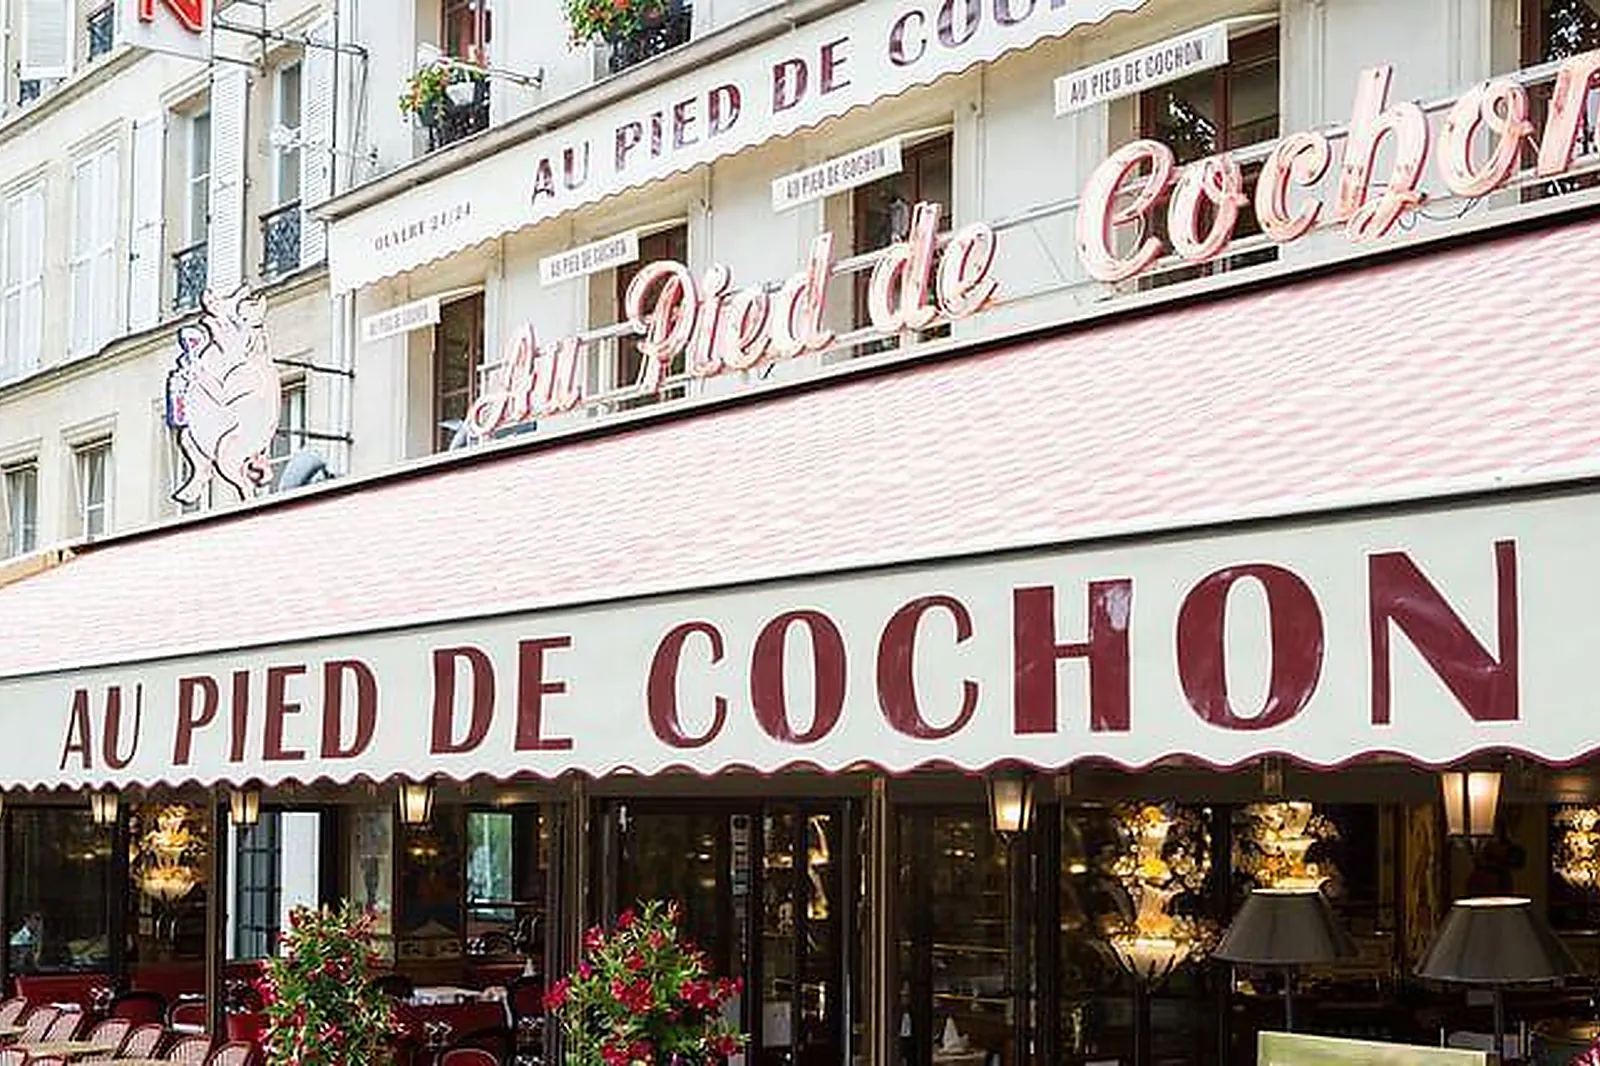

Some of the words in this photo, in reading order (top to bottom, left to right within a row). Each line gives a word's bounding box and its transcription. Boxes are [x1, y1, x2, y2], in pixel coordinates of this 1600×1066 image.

[531, 141, 590, 205] AU
[614, 84, 742, 173] PIED
[772, 36, 851, 114] DE
[1070, 79, 1088, 104] AU
[1092, 66, 1122, 96] PIED
[1124, 59, 1142, 87] DE
[1145, 40, 1204, 78] COCHON
[468, 319, 586, 437] Au
[625, 231, 837, 398] Pied
[869, 200, 999, 331] de
[60, 683, 142, 771] AU
[172, 659, 378, 766] PIED
[430, 635, 573, 754] DE
[647, 540, 1519, 748] COCHON
